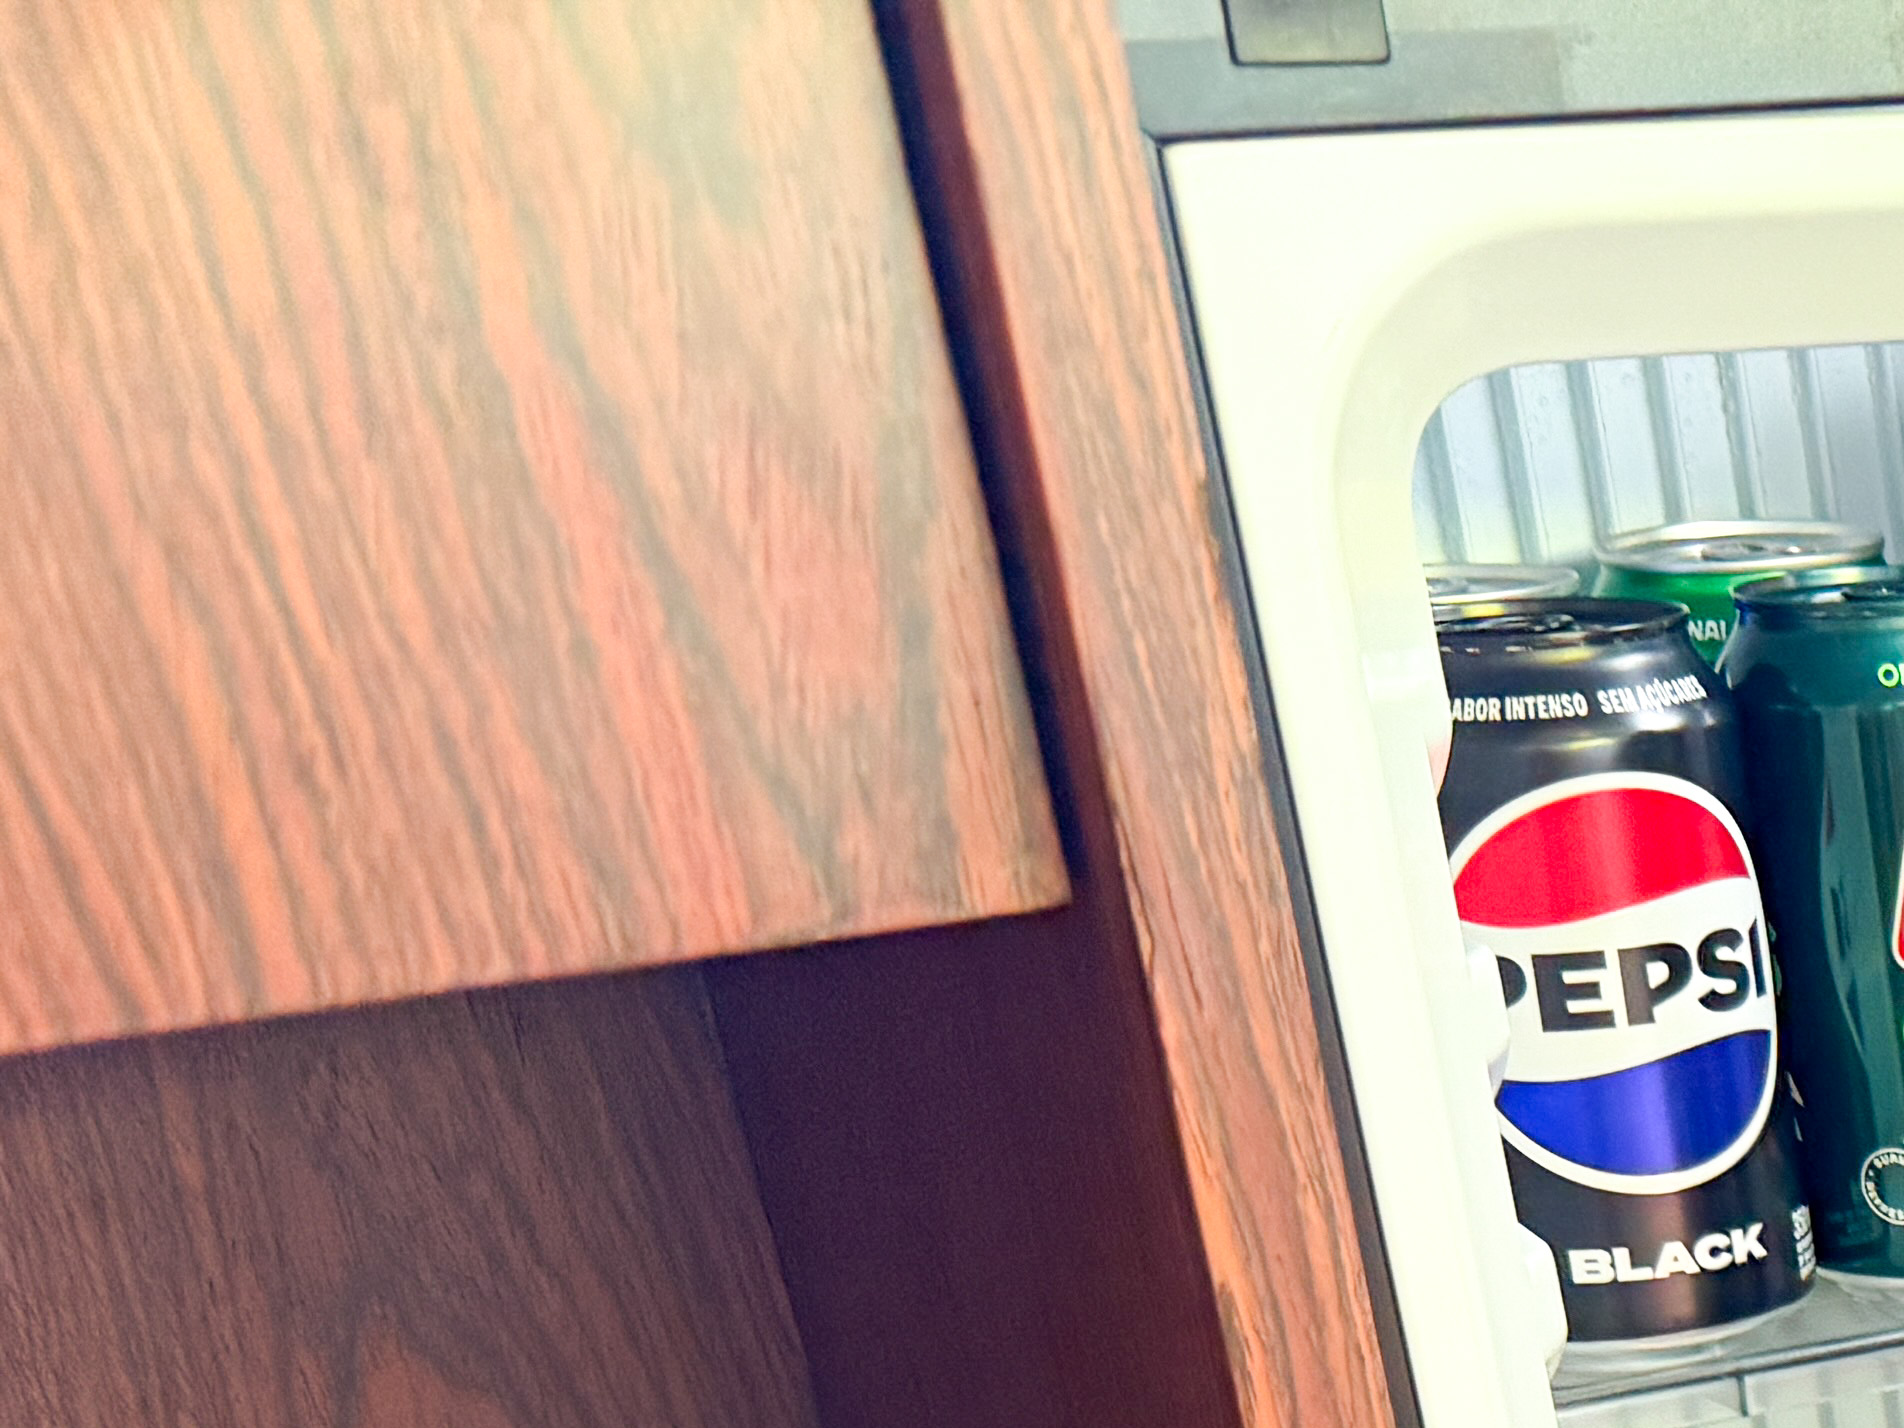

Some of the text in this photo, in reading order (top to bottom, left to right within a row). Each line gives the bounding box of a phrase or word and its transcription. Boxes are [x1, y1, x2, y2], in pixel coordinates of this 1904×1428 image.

[1451, 674, 1708, 722] ABOR INTENSO SEM AÇÚCARES
[1567, 1222, 1768, 1285] BLACK
